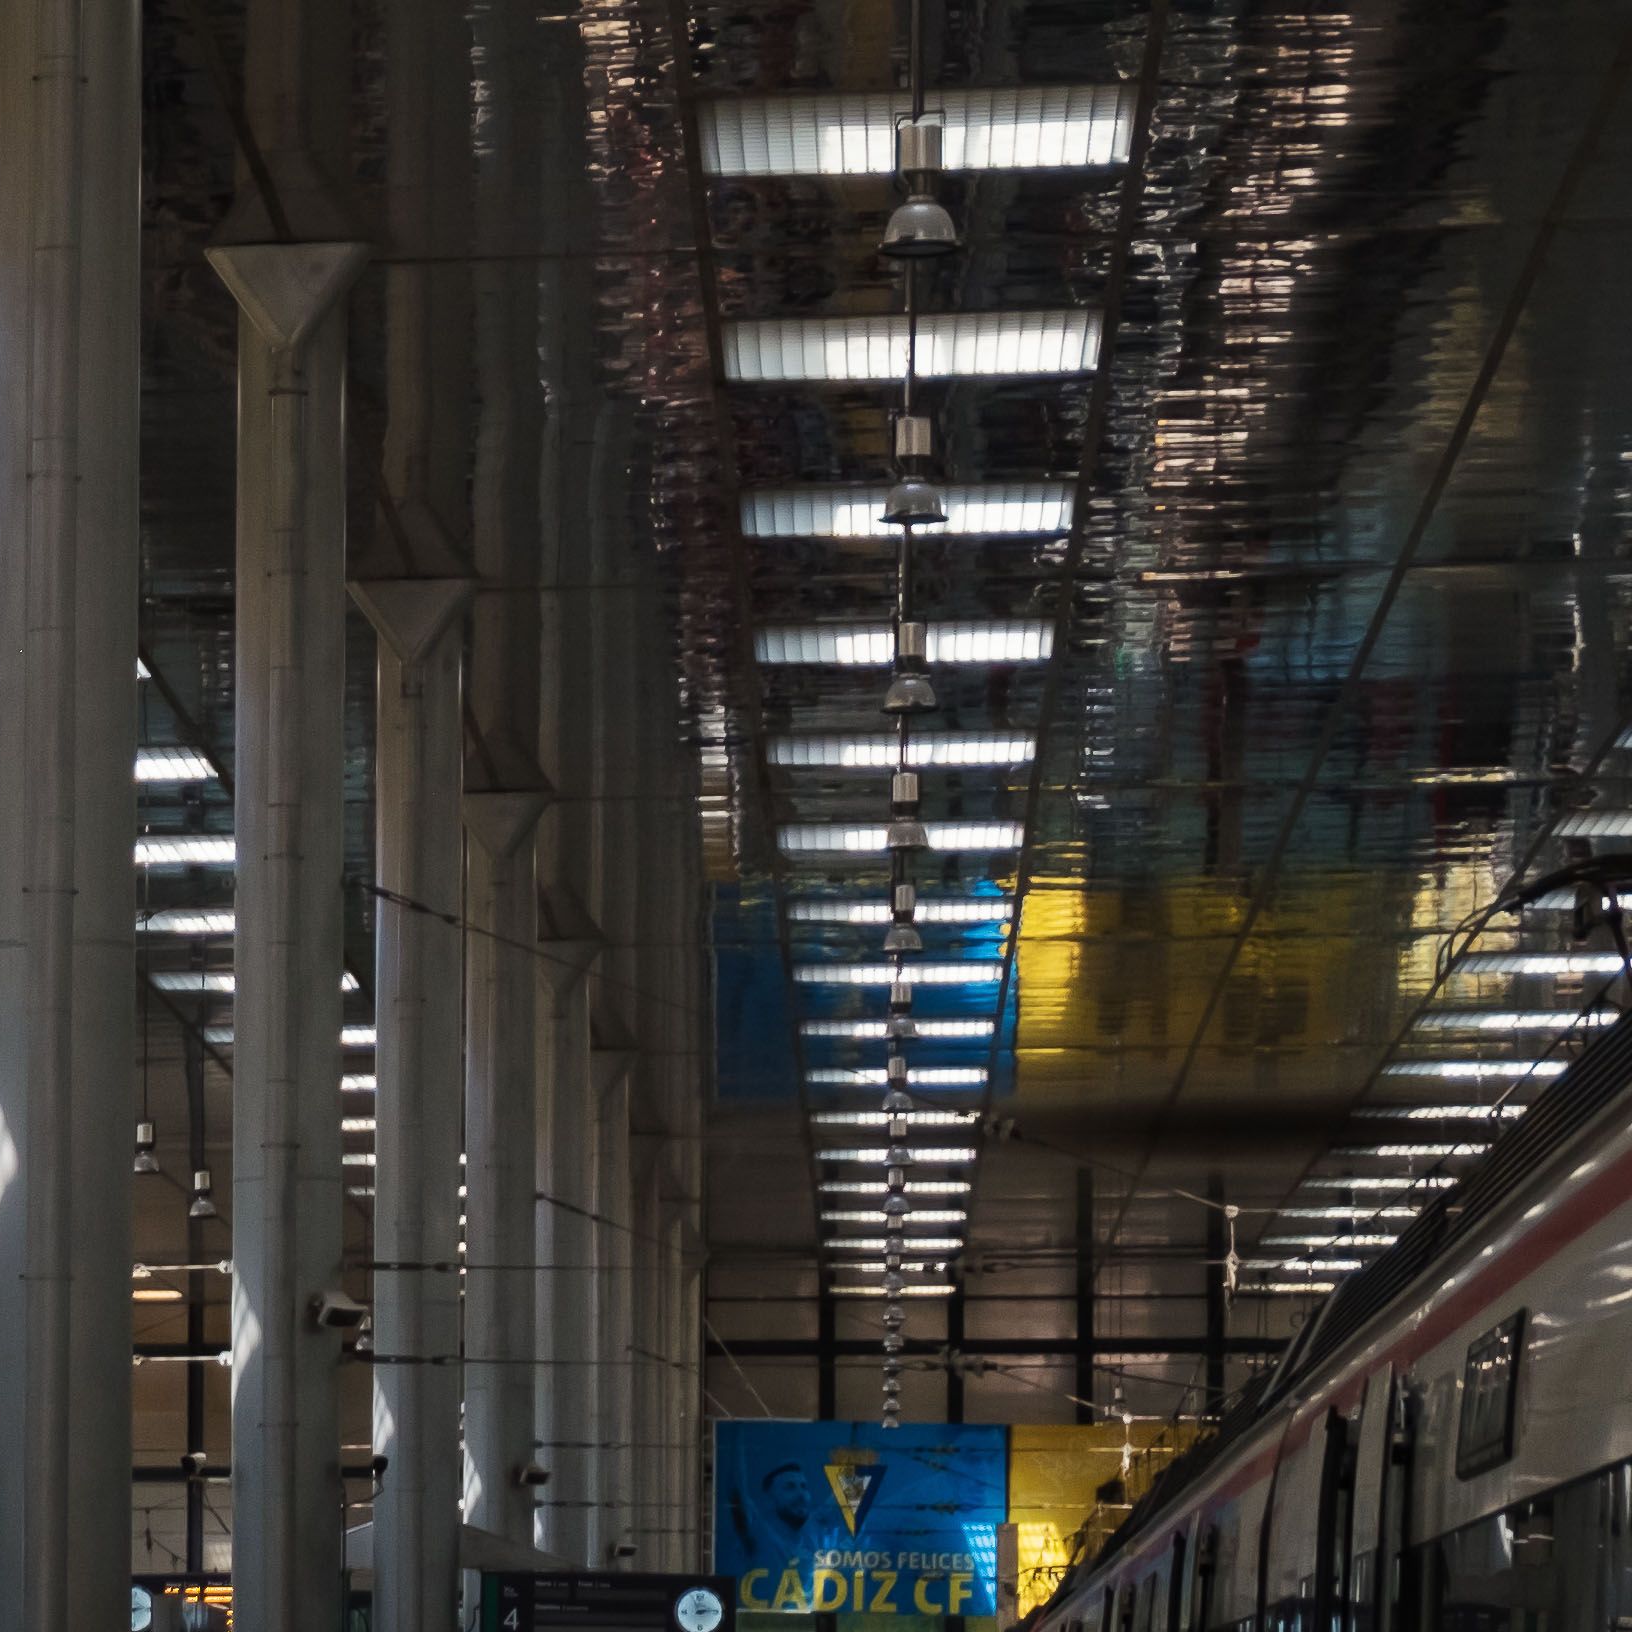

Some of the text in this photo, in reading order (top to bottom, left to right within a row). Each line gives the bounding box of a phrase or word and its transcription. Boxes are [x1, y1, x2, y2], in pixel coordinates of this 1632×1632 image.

[813, 1549, 976, 1571] SOMOS FELICES
[739, 1557, 975, 1615] CÁDIZ CF
[503, 1608, 520, 1632] 4
